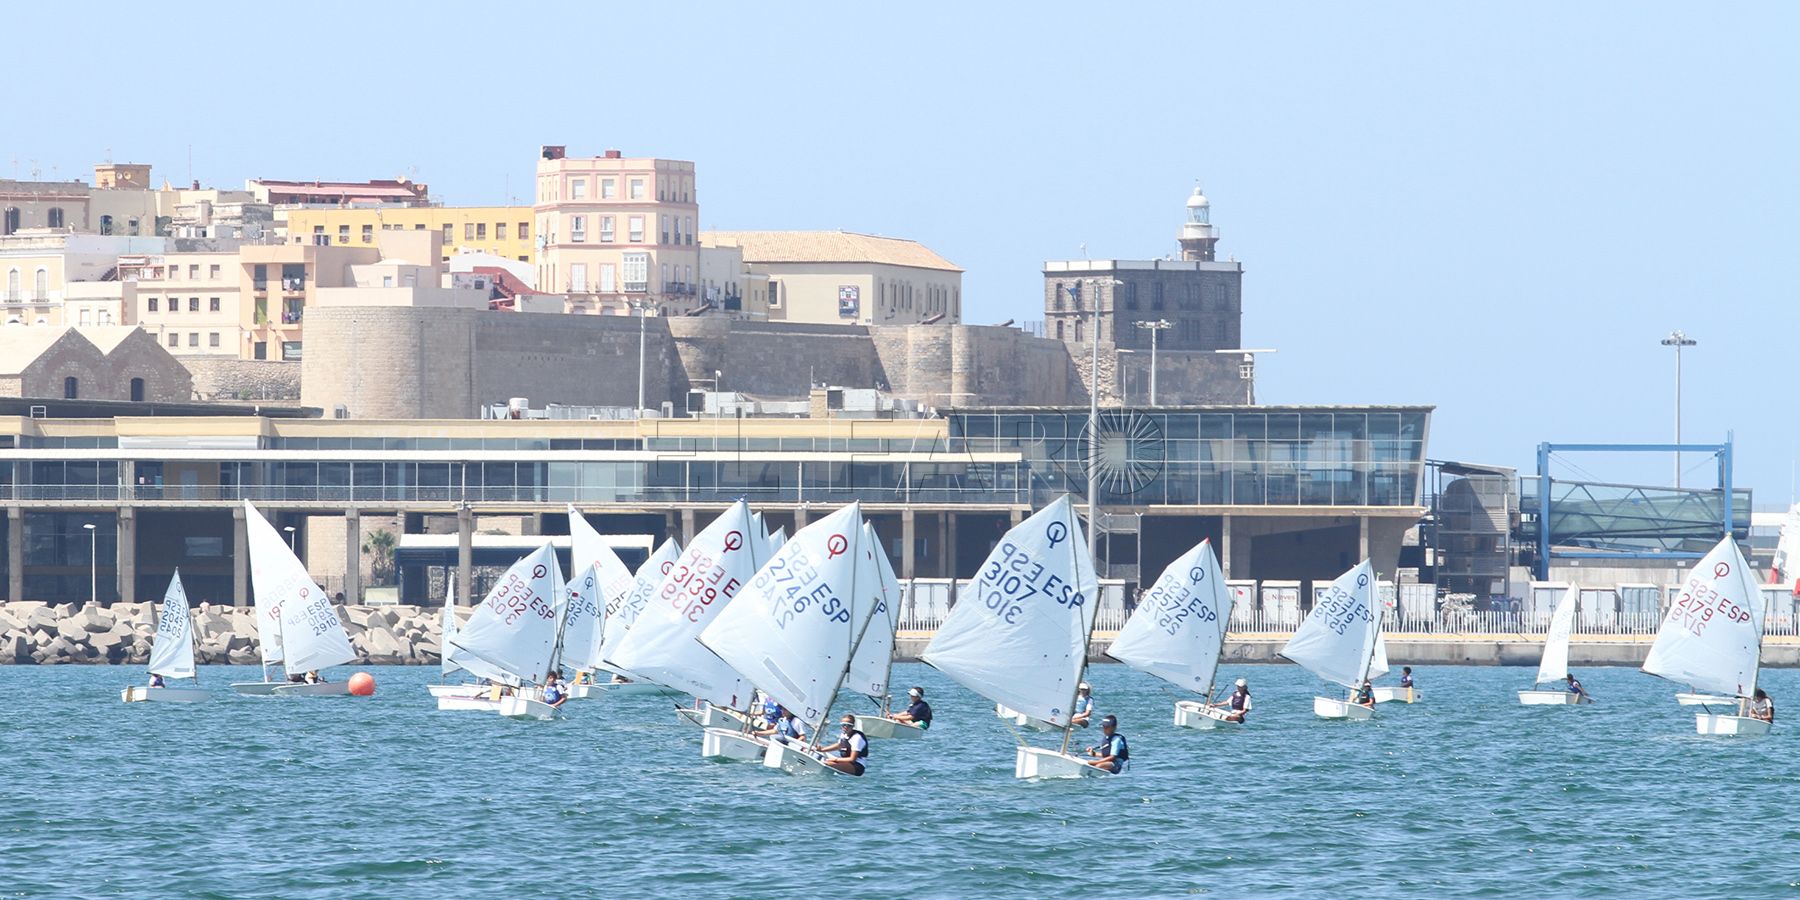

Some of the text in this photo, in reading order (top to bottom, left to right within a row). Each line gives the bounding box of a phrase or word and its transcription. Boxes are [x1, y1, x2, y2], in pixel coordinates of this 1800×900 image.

[673, 566, 717, 606] 3139
[769, 558, 811, 614] 2746
[984, 561, 1038, 602] 3107
[1042, 574, 1085, 610] ESP
[307, 598, 327, 616] ESP
[530, 596, 555, 620] ESP
[810, 583, 850, 624] ESP
[1151, 586, 1189, 623] 2572
[1188, 597, 1216, 623] ESP
[1320, 596, 1355, 624] 2579
[1678, 592, 1714, 622] 2179
[1717, 598, 1750, 624] ESP
[312, 616, 338, 637] 2910
